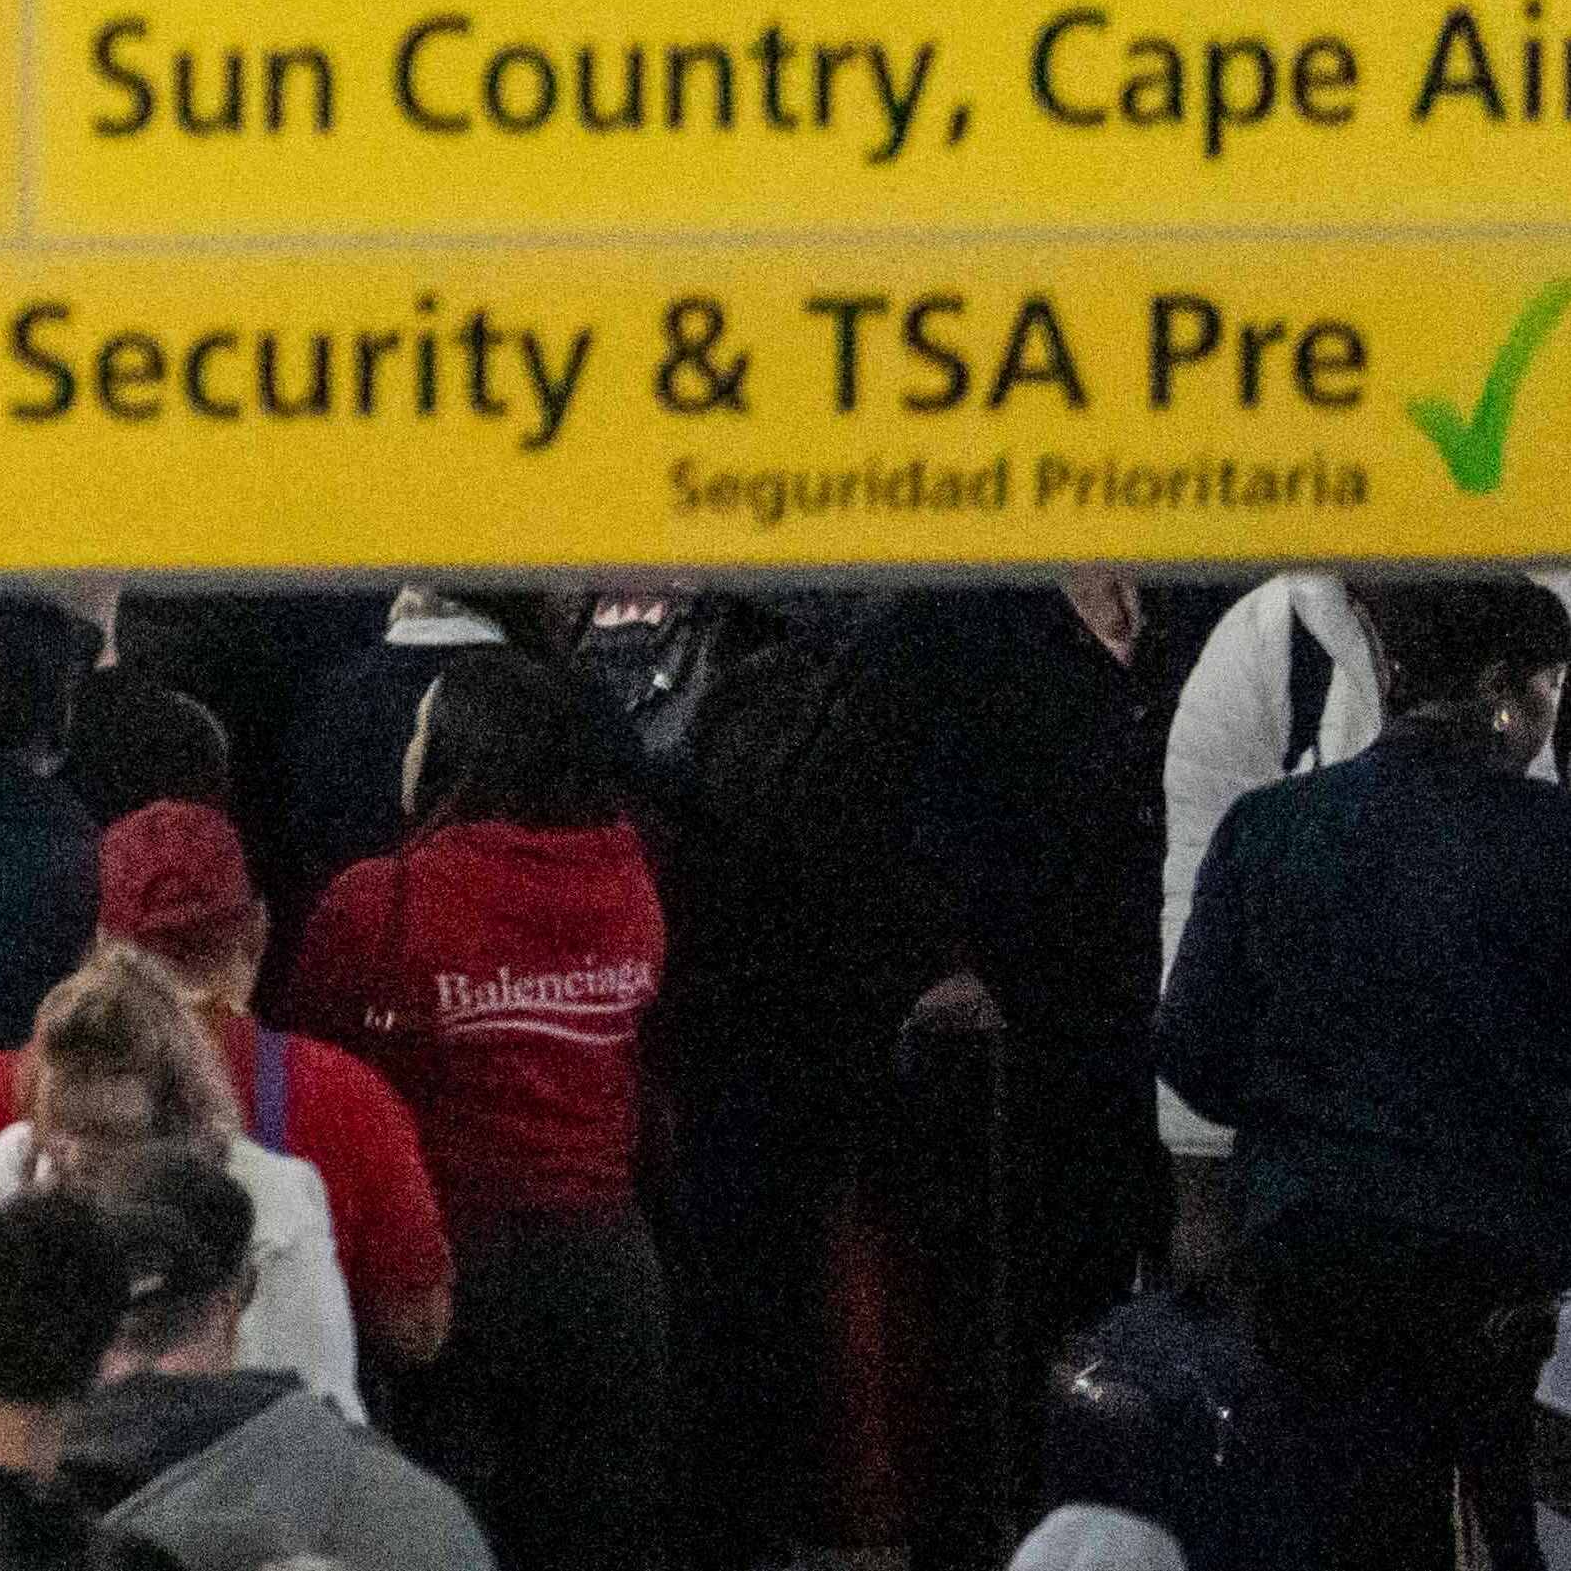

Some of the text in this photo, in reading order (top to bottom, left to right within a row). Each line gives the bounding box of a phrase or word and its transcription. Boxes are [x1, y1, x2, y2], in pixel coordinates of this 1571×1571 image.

[91, 17, 336, 139] Sun
[392, 13, 971, 166] Country,
[1029, 8, 1360, 162] Cape
[1412, 0, 1571, 122] Ai
[8, 294, 594, 453] Security
[654, 296, 750, 415] &
[807, 294, 1089, 415] TSA
[1149, 293, 1369, 410] Pre
[669, 455, 1012, 530] Seguridad
[1035, 455, 1370, 509] Prioritaria
[433, 960, 656, 1013] Balenciaga
